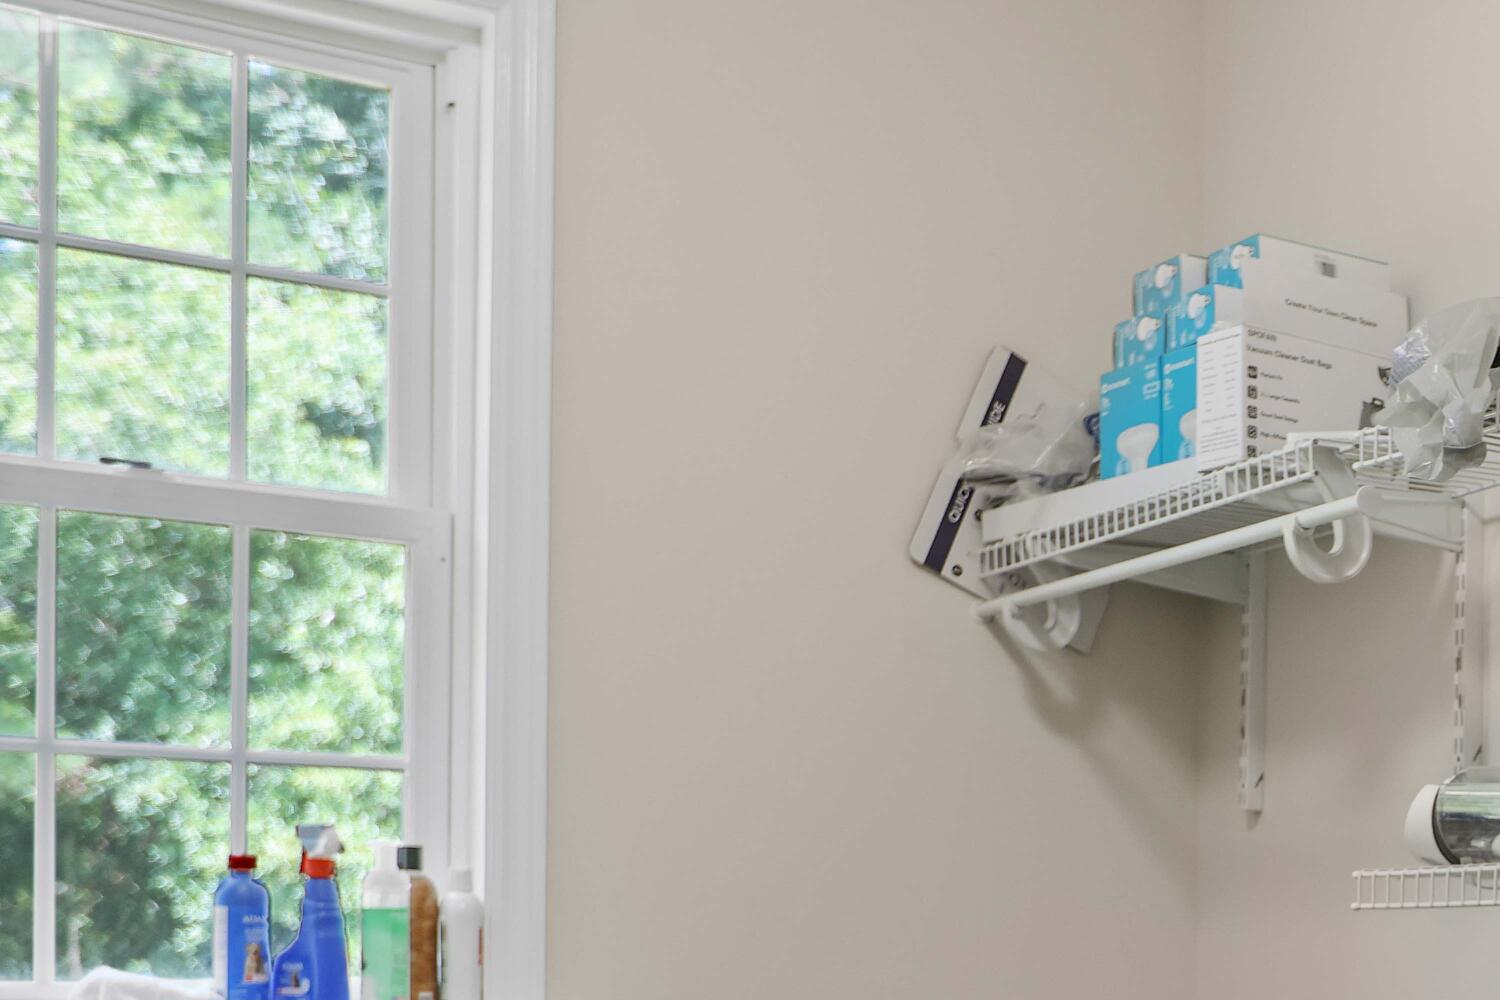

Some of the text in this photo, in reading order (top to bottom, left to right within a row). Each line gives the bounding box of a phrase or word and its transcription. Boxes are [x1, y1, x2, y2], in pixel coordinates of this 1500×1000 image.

[1248, 345, 1273, 356] Vacuum
[1275, 350, 1299, 361] Cleaner
[1317, 359, 1333, 370] Bags
